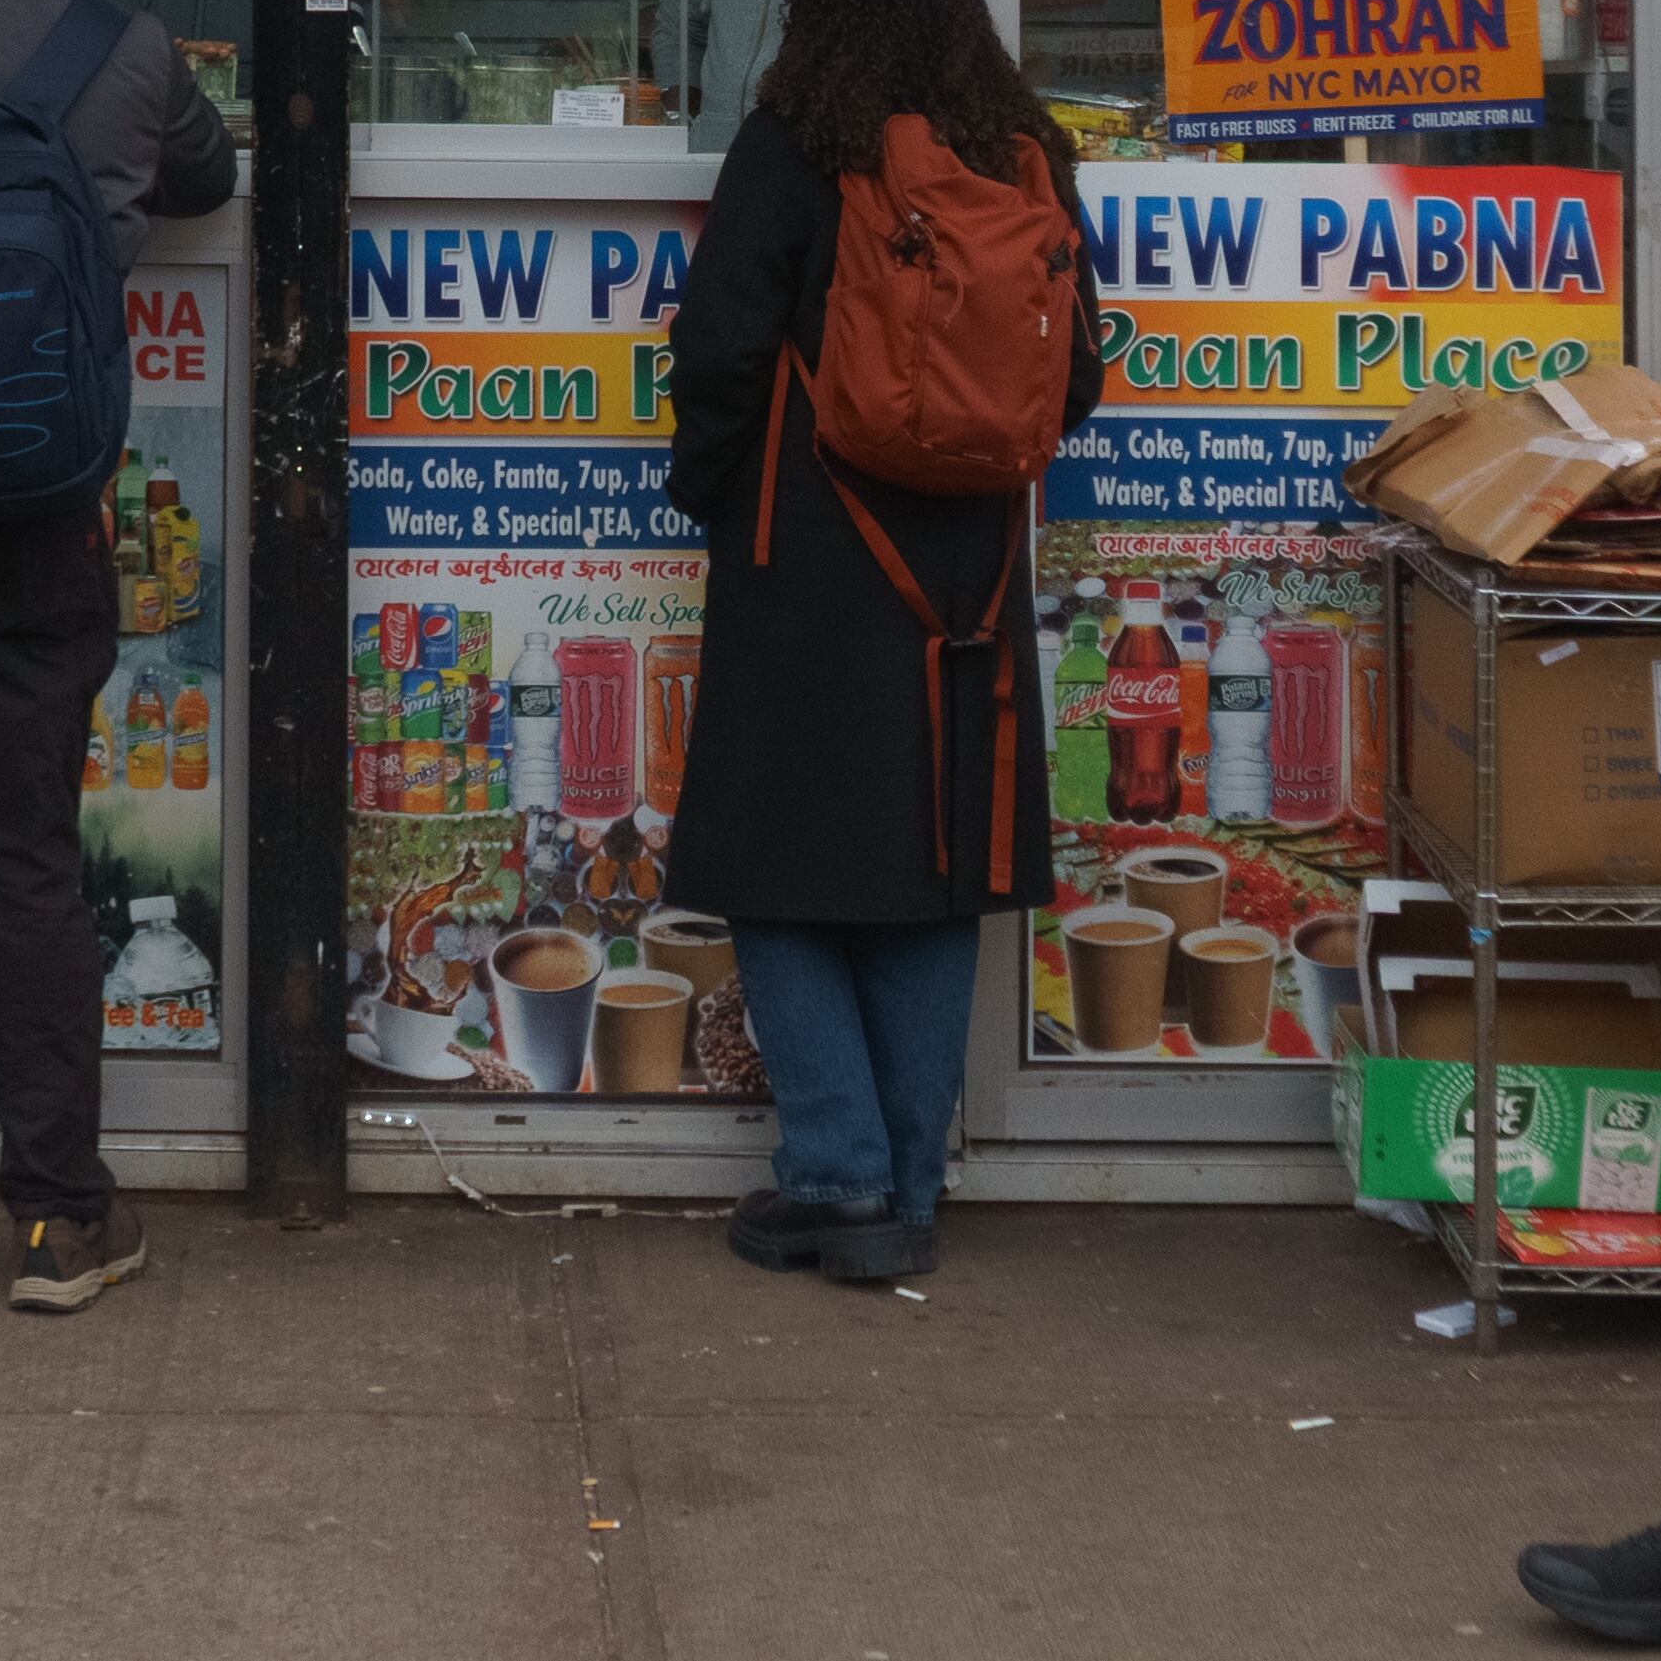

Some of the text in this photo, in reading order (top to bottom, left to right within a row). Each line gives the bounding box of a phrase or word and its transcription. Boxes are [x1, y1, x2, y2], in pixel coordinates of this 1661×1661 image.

[1222, 64, 1482, 102] FOR NYC MAYOR
[1176, 106, 1536, 139] FAST & FREE BUSES RENT FREEZE CHILDCARE FOR ALL
[346, 458, 630, 497] Soda, Coke, Fanta, 7up,
[385, 505, 581, 544] Water, & Special
